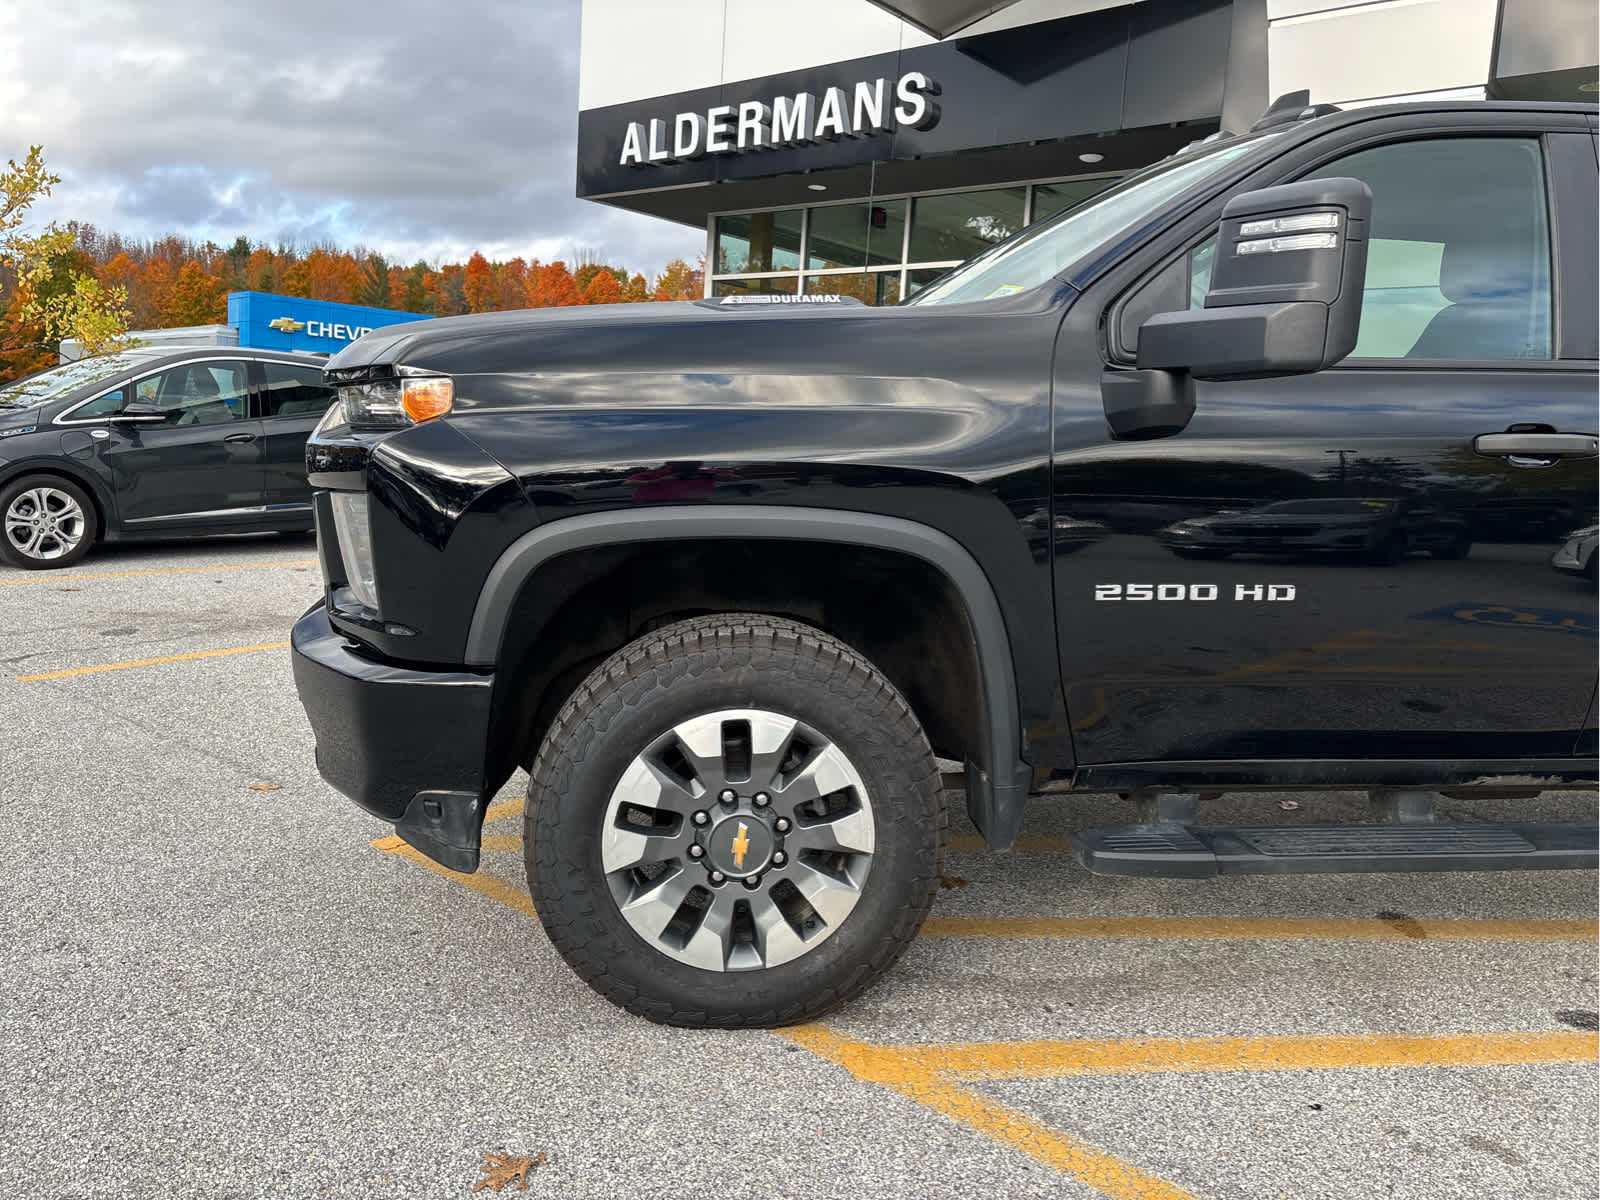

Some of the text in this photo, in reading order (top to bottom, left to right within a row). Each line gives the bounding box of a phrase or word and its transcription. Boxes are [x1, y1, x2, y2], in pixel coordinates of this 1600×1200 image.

[620, 71, 934, 166] ALDERMANS
[771, 294, 841, 304] DURAMAX
[1094, 583, 1297, 601] 2500 HD
